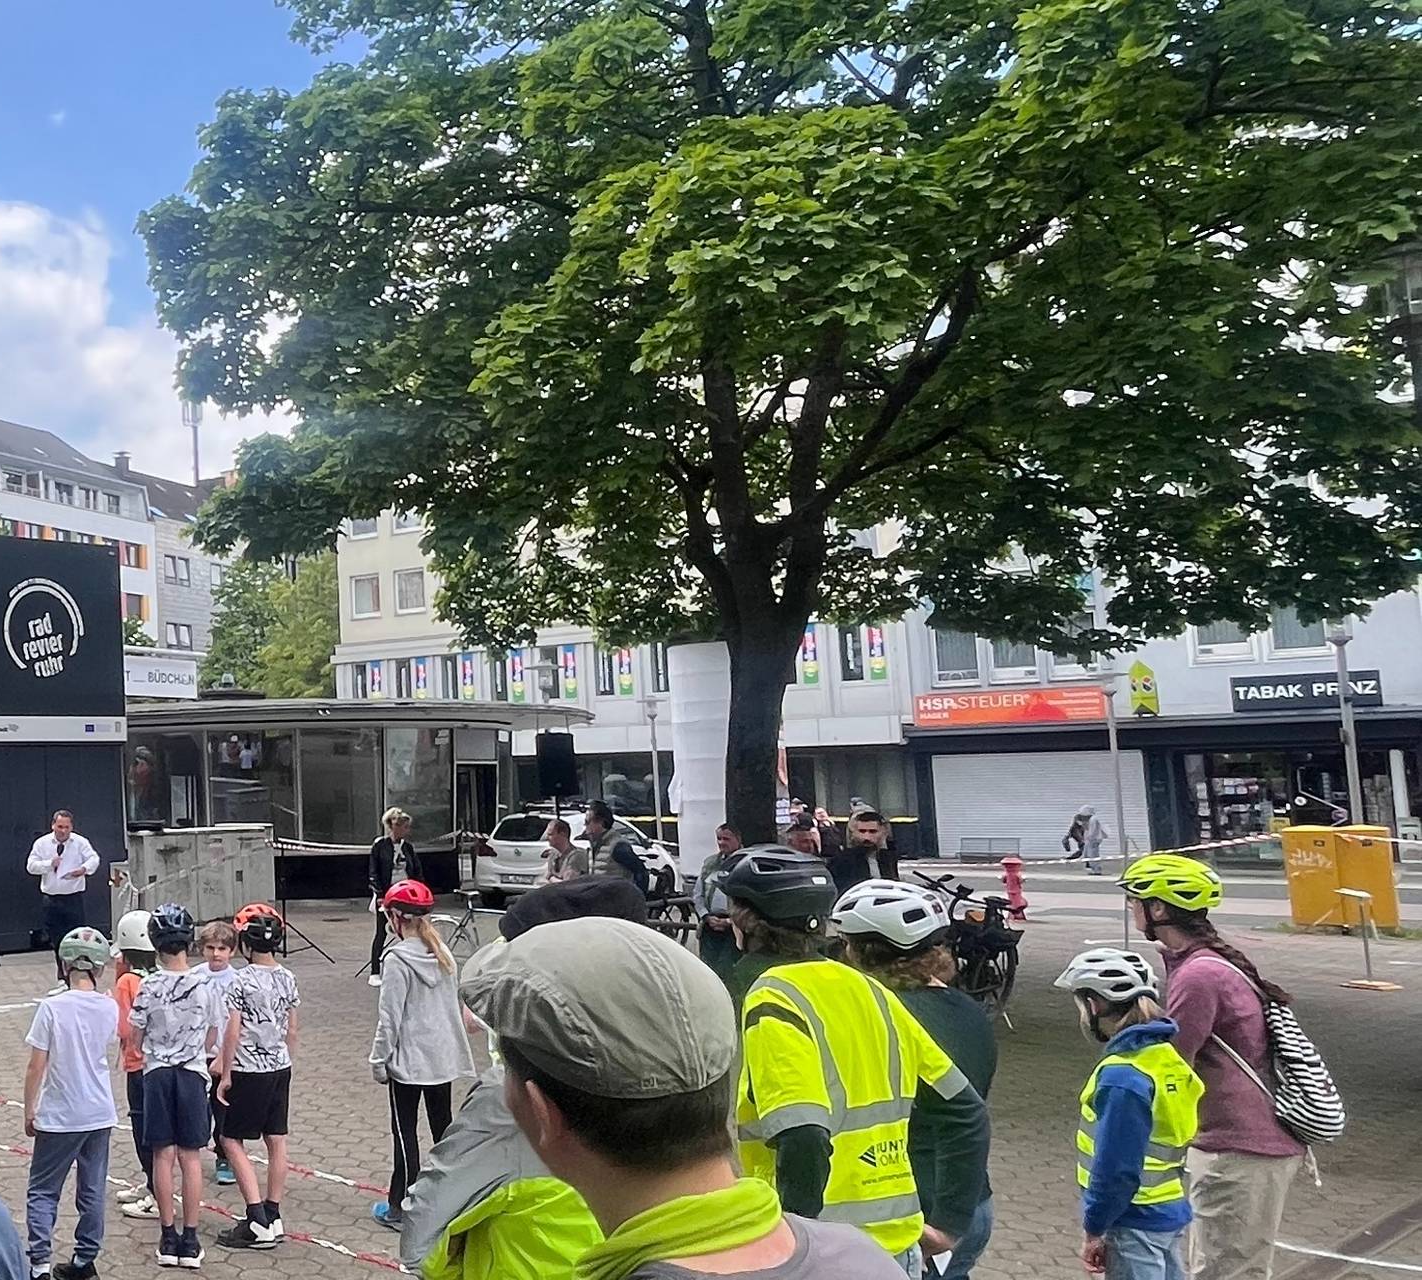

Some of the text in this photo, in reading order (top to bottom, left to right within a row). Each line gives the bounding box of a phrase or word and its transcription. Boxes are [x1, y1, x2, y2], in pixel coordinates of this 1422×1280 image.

[27, 612, 53, 638] rad
[22, 633, 64, 660] revier
[33, 655, 64, 678] ruhr
[1234, 679, 1378, 700] TABAK PRNZ
